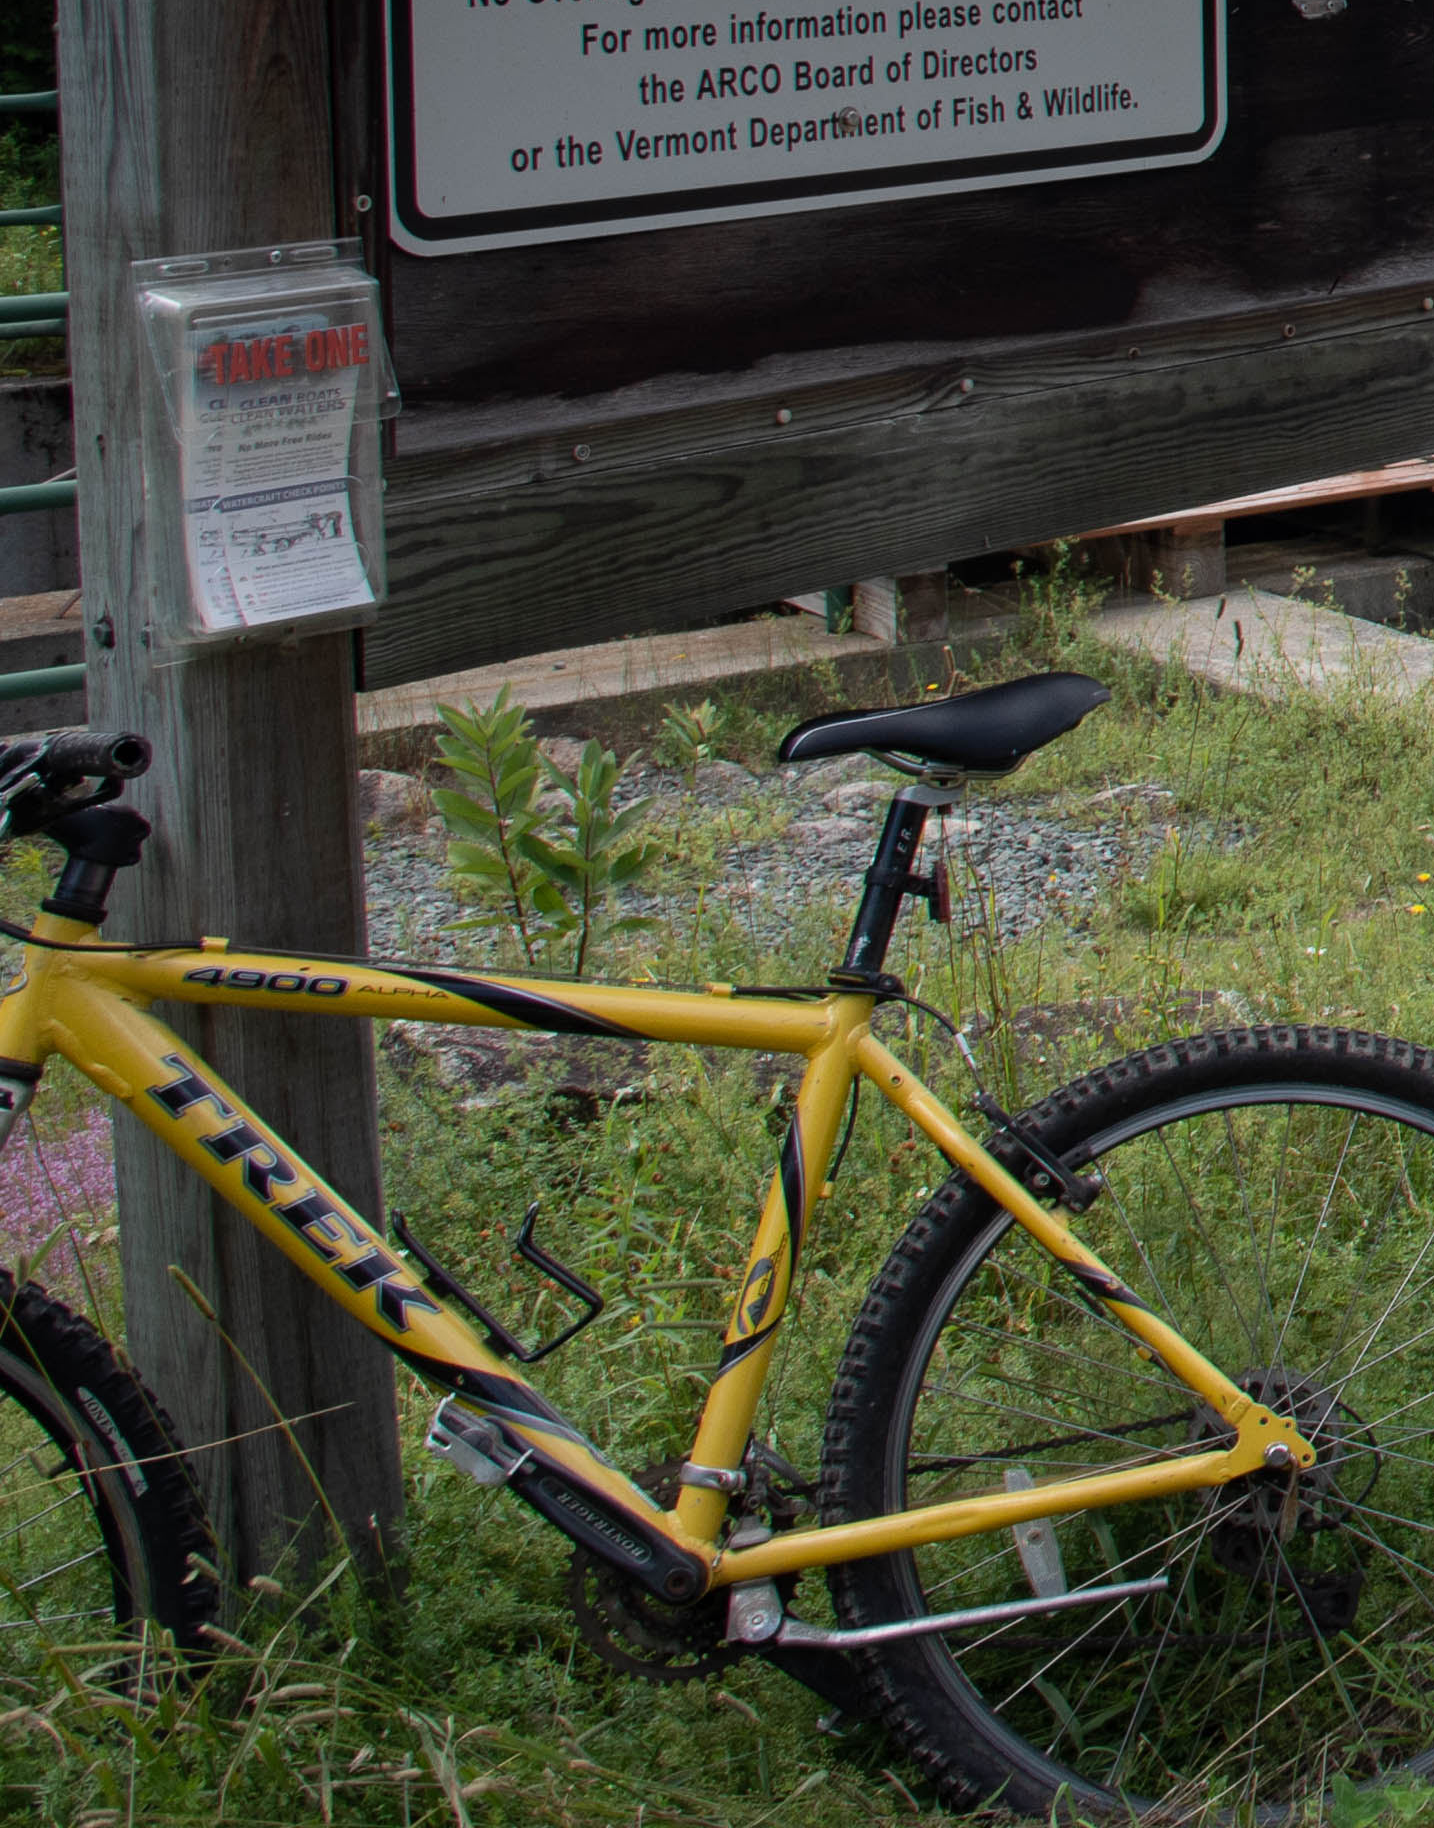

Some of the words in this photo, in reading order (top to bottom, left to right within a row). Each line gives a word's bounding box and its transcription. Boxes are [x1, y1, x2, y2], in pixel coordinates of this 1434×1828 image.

[582, 23, 632, 56] For
[644, 23, 717, 51] more
[730, 5, 887, 45] information
[899, 0, 981, 40] please
[638, 73, 685, 106] the
[696, 63, 782, 101] ARCO
[794, 55, 874, 92] Board
[886, 51, 913, 84] of
[923, 46, 1038, 80] Directors
[511, 146, 543, 173] or
[555, 135, 603, 169] the
[615, 121, 738, 162] Vermont
[916, 99, 943, 131] of
[952, 94, 1005, 127] Fish
[1016, 91, 1034, 121] &
[1043, 82, 1138, 117] Wildlife.
[208, 335, 294, 386] TAKE
[306, 323, 369, 373] ONE
[240, 393, 292, 411] CLEAN
[297, 388, 342, 403] BOATS
[183, 966, 350, 996] 4900
[358, 985, 448, 999] ALPHA
[144, 1052, 442, 1333] TREK
[82, 1397, 117, 1435] JONES
[557, 1492, 645, 1557] BONTRAGER
